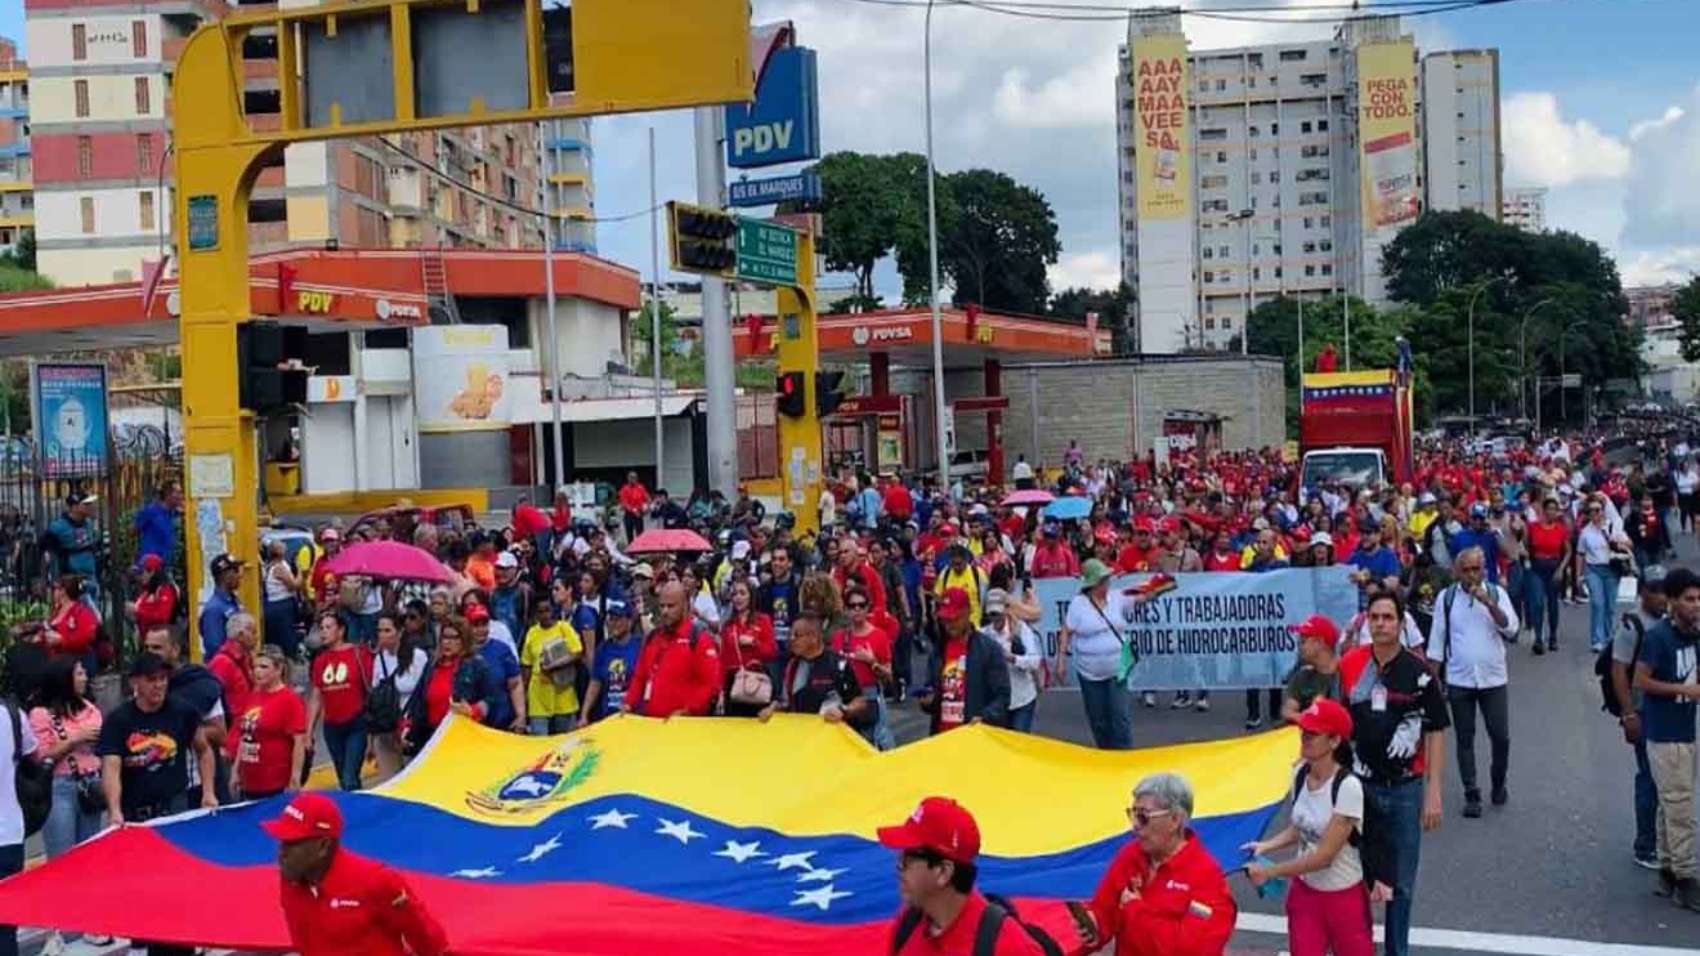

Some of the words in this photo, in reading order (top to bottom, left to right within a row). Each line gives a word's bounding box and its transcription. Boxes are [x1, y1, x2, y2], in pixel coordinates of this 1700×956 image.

[1139, 57, 1182, 76] AAA
[1140, 75, 1181, 93] AAY
[1367, 77, 1408, 92] PEGA
[1138, 94, 1185, 112] MAA
[1370, 92, 1403, 105] CON
[1141, 112, 1182, 129] VEE
[734, 119, 794, 157] PDV
[299, 291, 333, 312] PDV
[873, 327, 912, 340] PDVSA
[1163, 598, 1173, 623] Y
[1177, 593, 1286, 623] TRABAJADORAS
[1157, 629, 1174, 655] DE
[1178, 625, 1296, 655] HIDROCARBUROS
